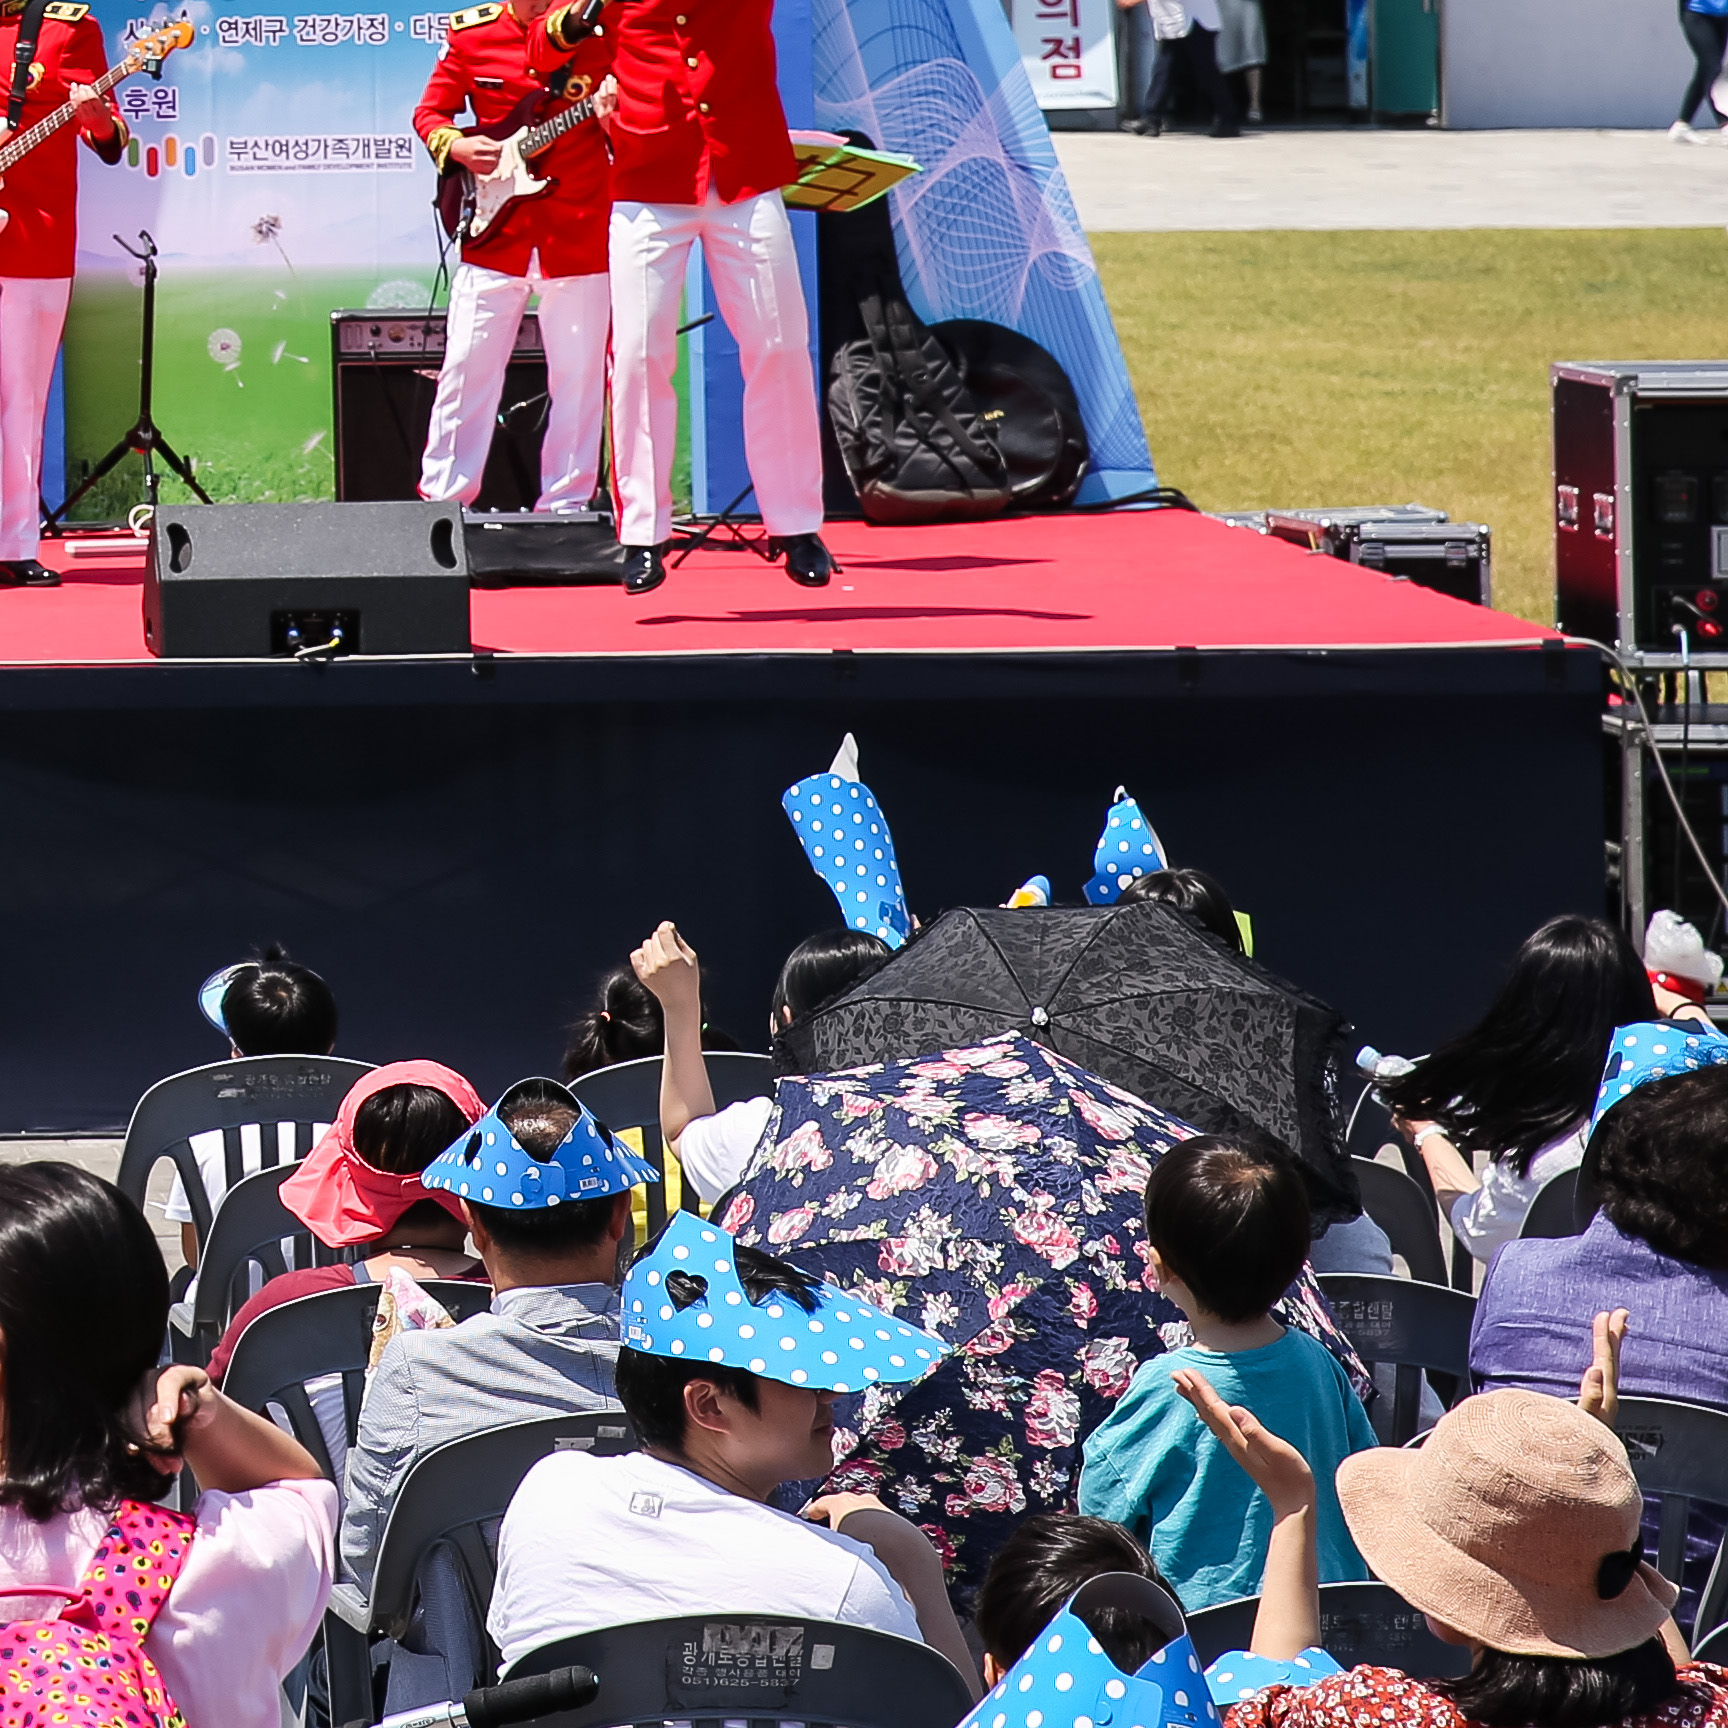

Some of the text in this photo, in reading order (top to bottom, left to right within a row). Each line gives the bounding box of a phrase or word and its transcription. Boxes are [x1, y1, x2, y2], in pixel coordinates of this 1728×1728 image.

[218, 19, 287, 45] 연제구
[295, 17, 387, 43] 건강가정
[123, 88, 178, 120] 후원
[228, 137, 413, 161] 부산여성가족개발원
